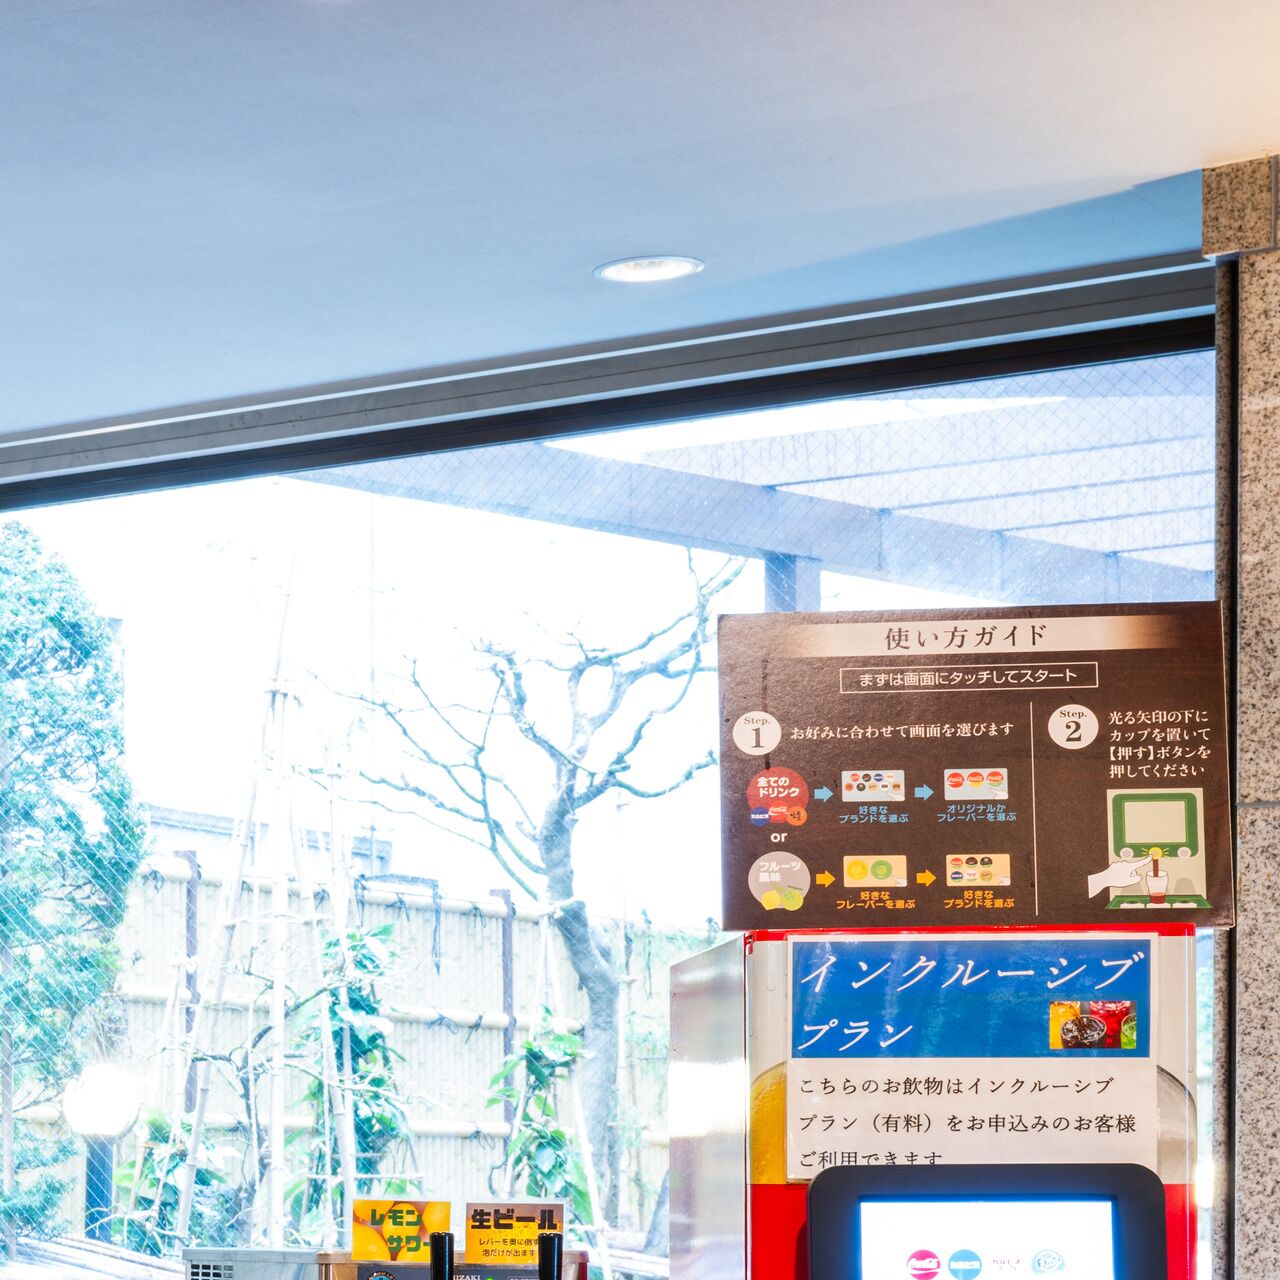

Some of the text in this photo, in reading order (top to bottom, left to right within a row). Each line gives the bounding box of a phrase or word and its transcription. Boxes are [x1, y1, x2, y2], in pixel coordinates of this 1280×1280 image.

[885, 623, 1047, 651] 使い方ガイド
[859, 667, 1078, 688] まずは画面にタッチしてスタート
[743, 716, 772, 726] Step.
[1059, 710, 1088, 720] Step.
[1107, 708, 1209, 726] 光る矢印の下に
[751, 727, 765, 749] 1
[789, 721, 1015, 741] お好みに合わせて画面を選びます
[1065, 721, 1083, 743] 2
[1109, 727, 1212, 744] カップを置いて
[1108, 745, 1212, 762] 【押す】ボタンを
[1109, 763, 1206, 780] 押してください
[756, 776, 790, 788] 全ての
[758, 786, 801, 799] ドリンク
[858, 805, 889, 815] 好きな
[936, 810, 1017, 823] フレーバーを選ぶ
[947, 803, 1007, 814] オリジナルか
[839, 812, 909, 824] ブランドを選ぶ
[770, 831, 788, 843] or
[759, 860, 802, 873] フルーツ
[860, 890, 891, 901] 好きな
[943, 897, 1016, 909] ブランドを選ぶ
[963, 889, 994, 900] 好きな
[836, 898, 916, 910] フレーバーを選ぶ
[800, 950, 1146, 993] インクルーシブ
[797, 1017, 914, 1052] プラン
[799, 1076, 1115, 1096] こちらのお飲物はインクルーシブ
[798, 1112, 1137, 1135] プラン（有料）をお申込みのお客様
[799, 1151, 943, 1168] ご利用できます
[370, 1208, 423, 1227] レモン
[470, 1208, 558, 1231] 生ビール
